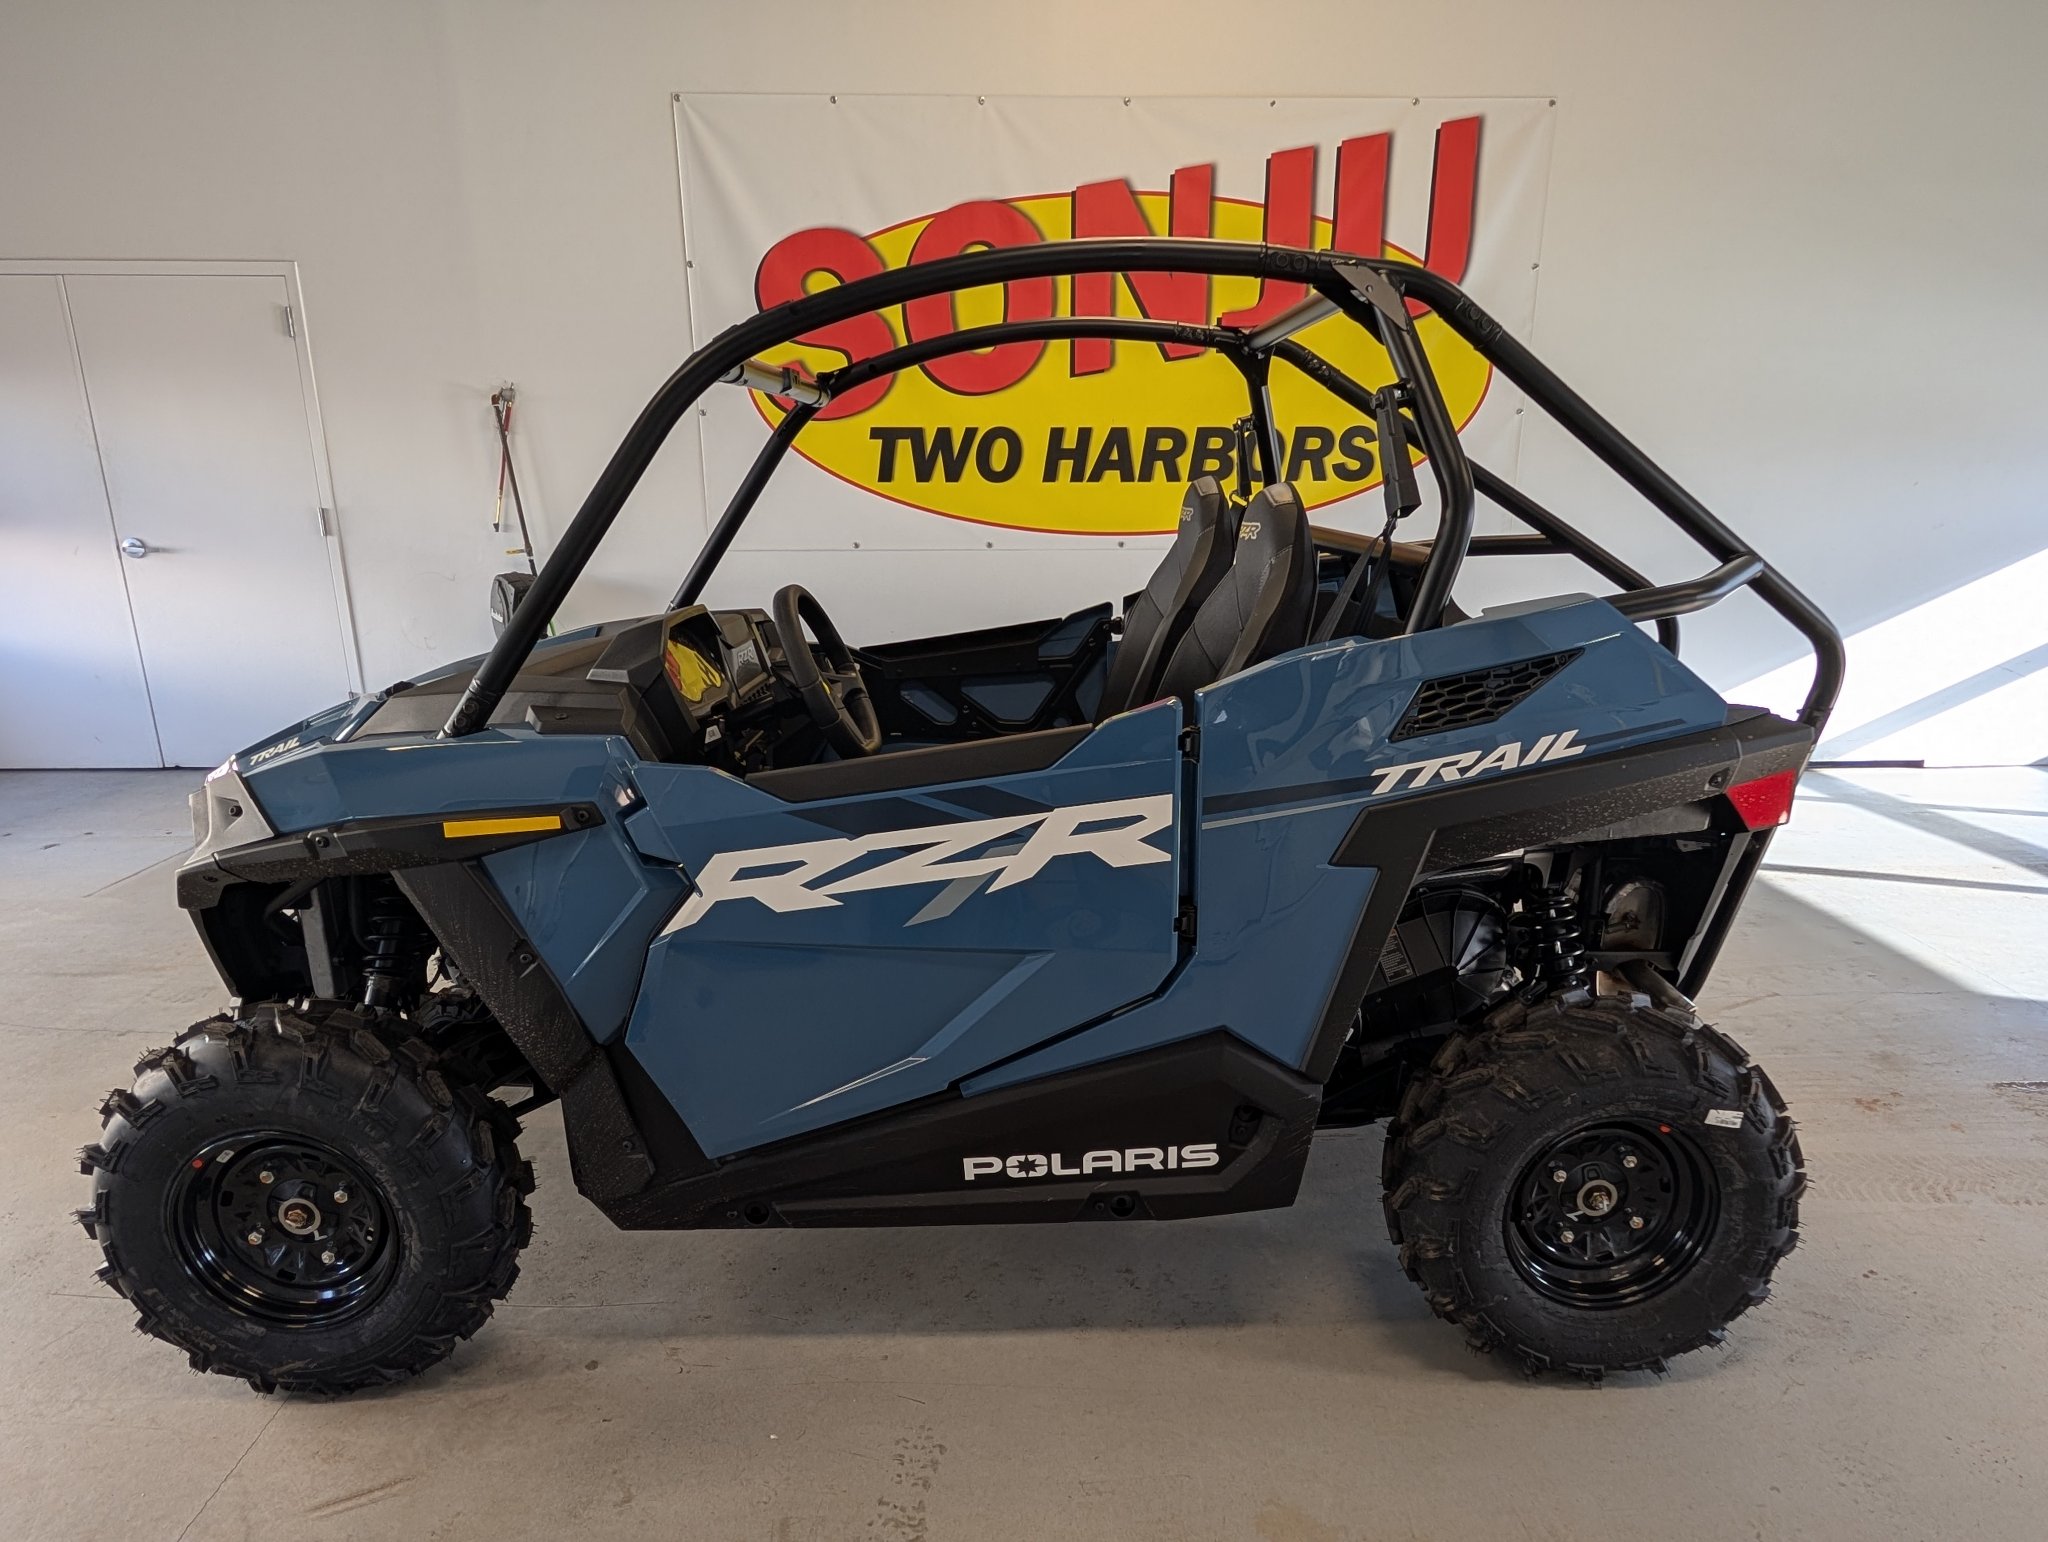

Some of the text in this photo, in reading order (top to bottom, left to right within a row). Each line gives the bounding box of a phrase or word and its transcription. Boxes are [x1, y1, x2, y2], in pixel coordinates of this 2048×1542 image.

[755, 115, 1481, 421] SONJU
[868, 426, 1022, 483] TWO
[249, 737, 300, 766] TRAIL
[1371, 729, 1587, 796] TRAIL
[660, 794, 1173, 937] RZR
[963, 1143, 1219, 1180] POLARIS
